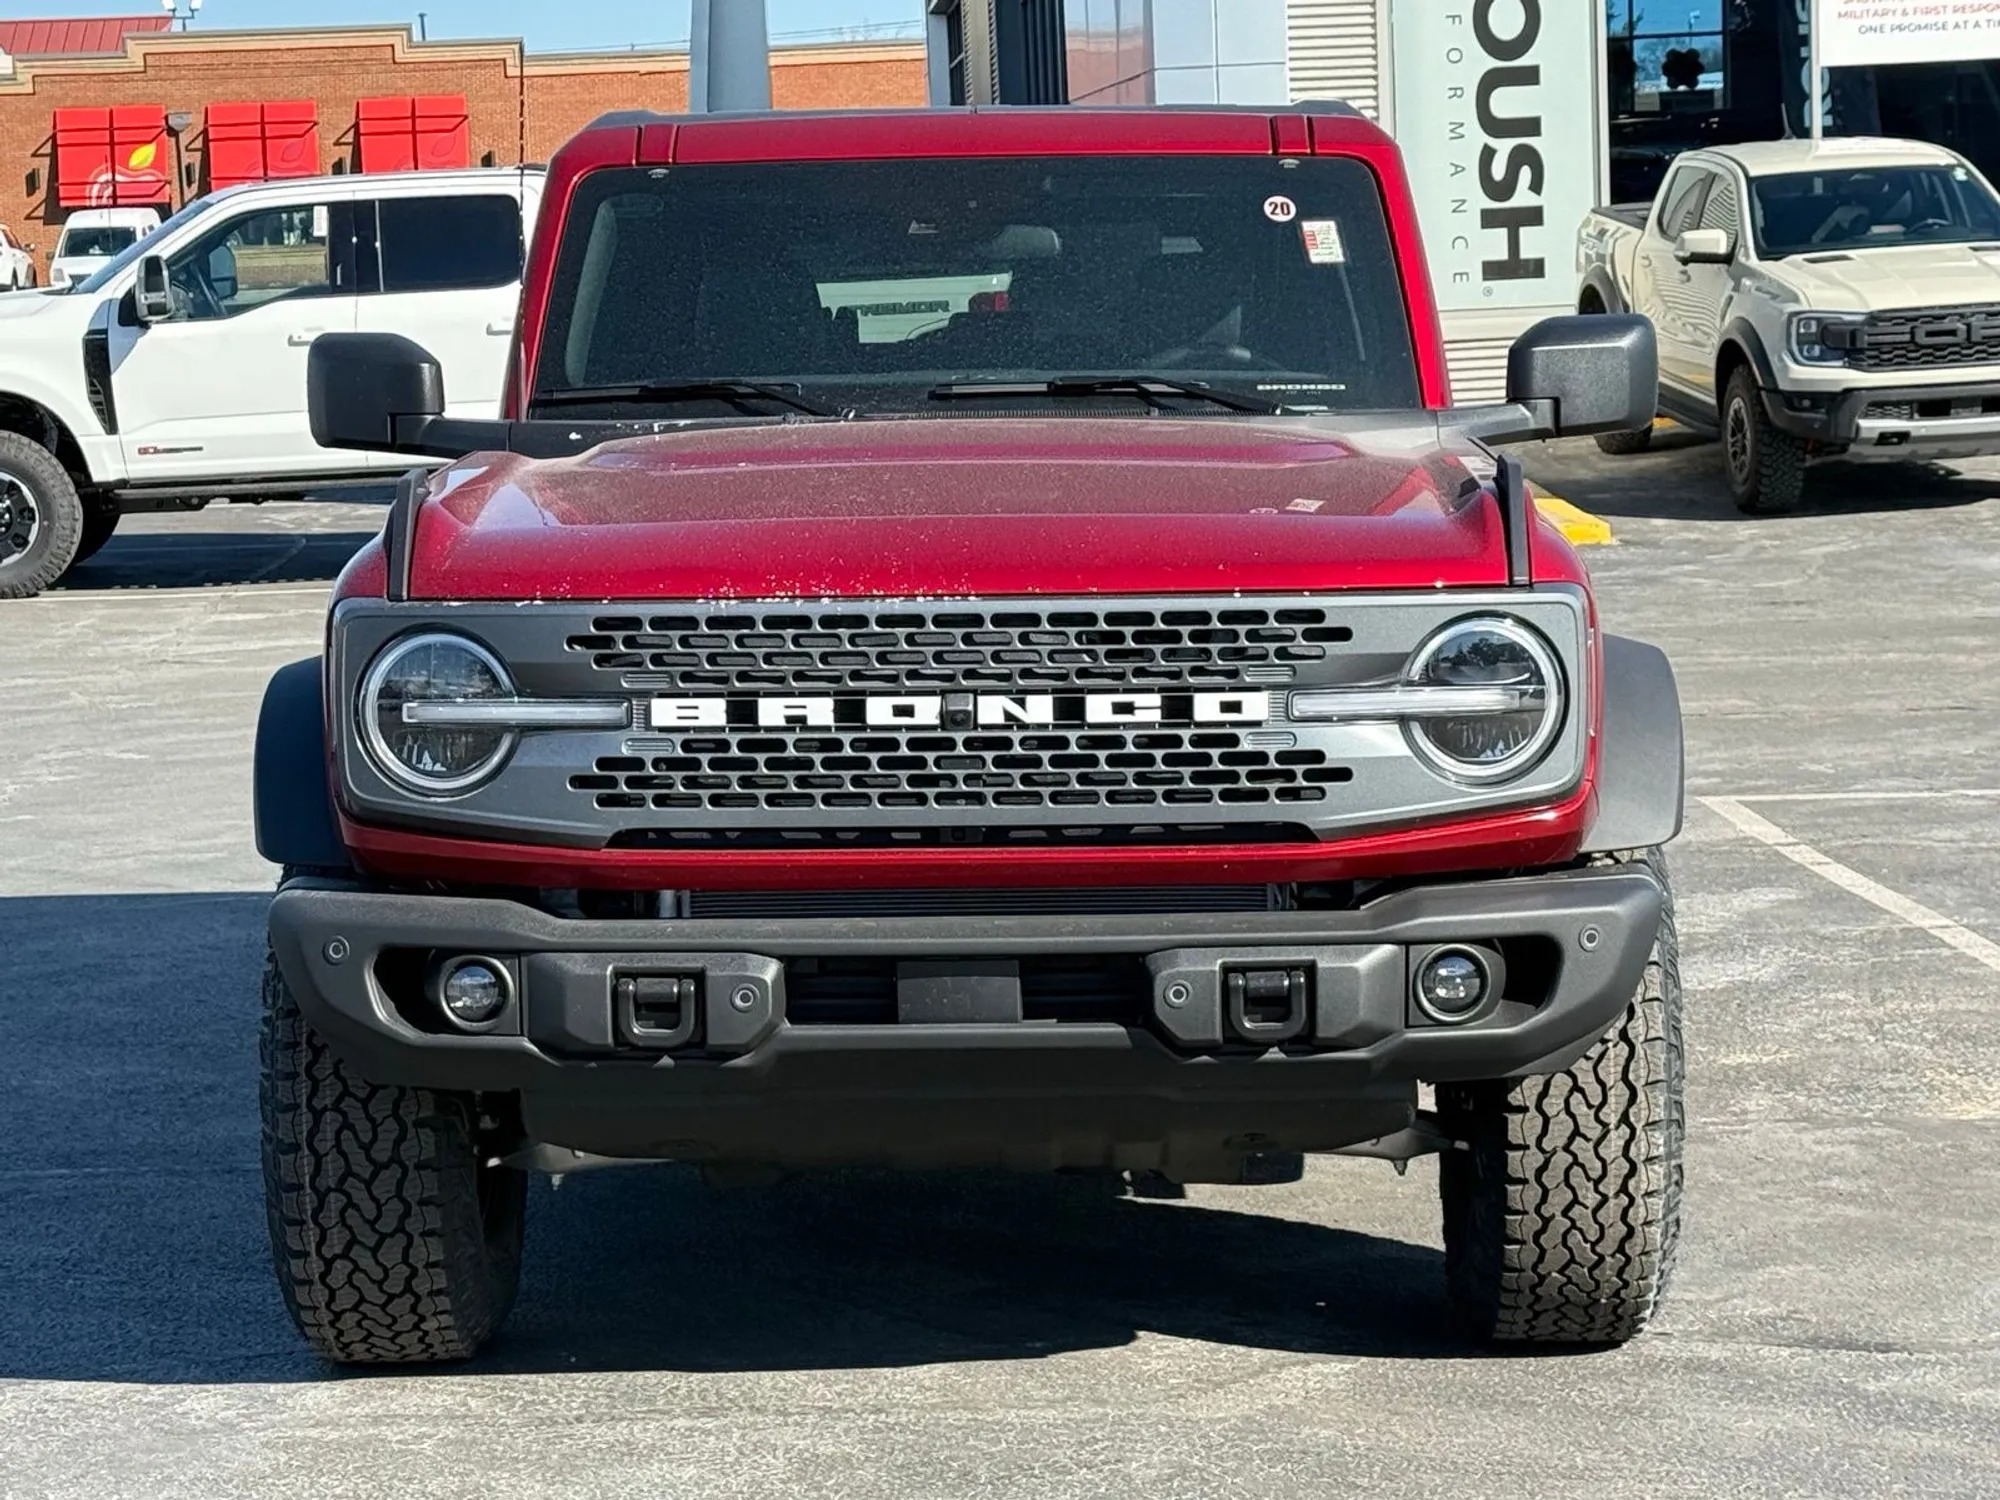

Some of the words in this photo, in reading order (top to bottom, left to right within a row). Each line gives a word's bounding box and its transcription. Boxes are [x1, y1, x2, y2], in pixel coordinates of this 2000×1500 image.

[1837, 8, 1898, 20] MILITARY
[1912, 5, 1948, 17] FIRST
[1858, 24, 1886, 35] ONE
[1890, 21, 1949, 33] PROMISE
[1952, 20, 1970, 31] AT
[1973, 19, 1982, 30] A
[1985, 18, 2000, 29] TI
[1445, 14, 1469, 284] FORMANCE
[1268, 201, 1291, 216] 20
[649, 691, 1271, 730] BRONCO
